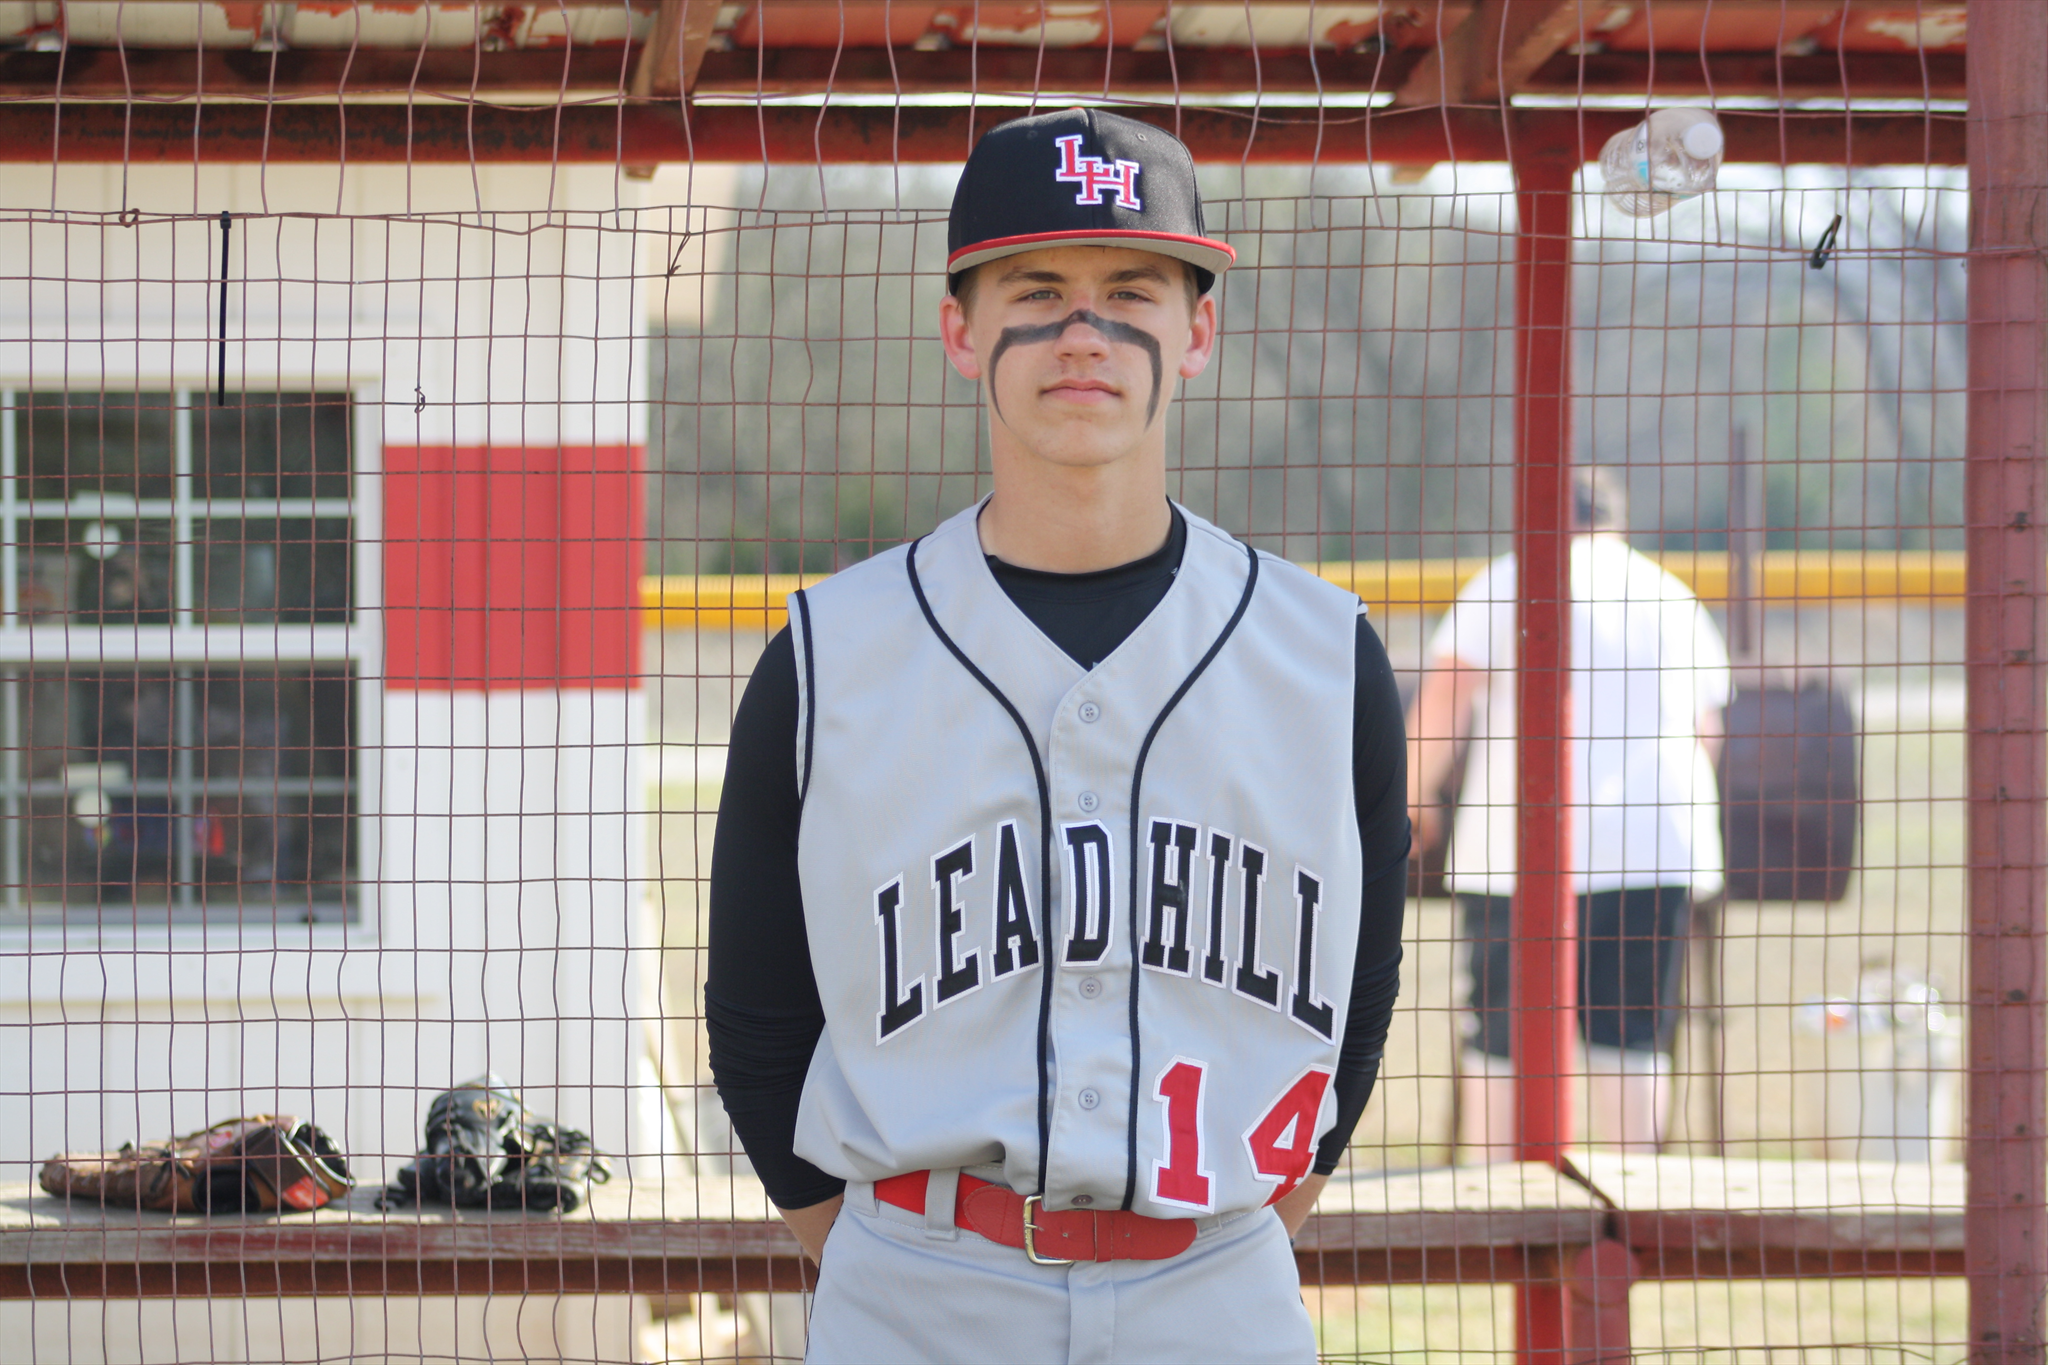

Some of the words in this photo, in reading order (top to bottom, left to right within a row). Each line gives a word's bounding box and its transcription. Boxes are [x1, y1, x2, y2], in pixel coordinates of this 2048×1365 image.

[1055, 134, 1141, 211] LH
[873, 818, 1115, 1047] LEAD
[1139, 816, 1338, 1047] HILL
[1149, 1054, 1335, 1214] 14
